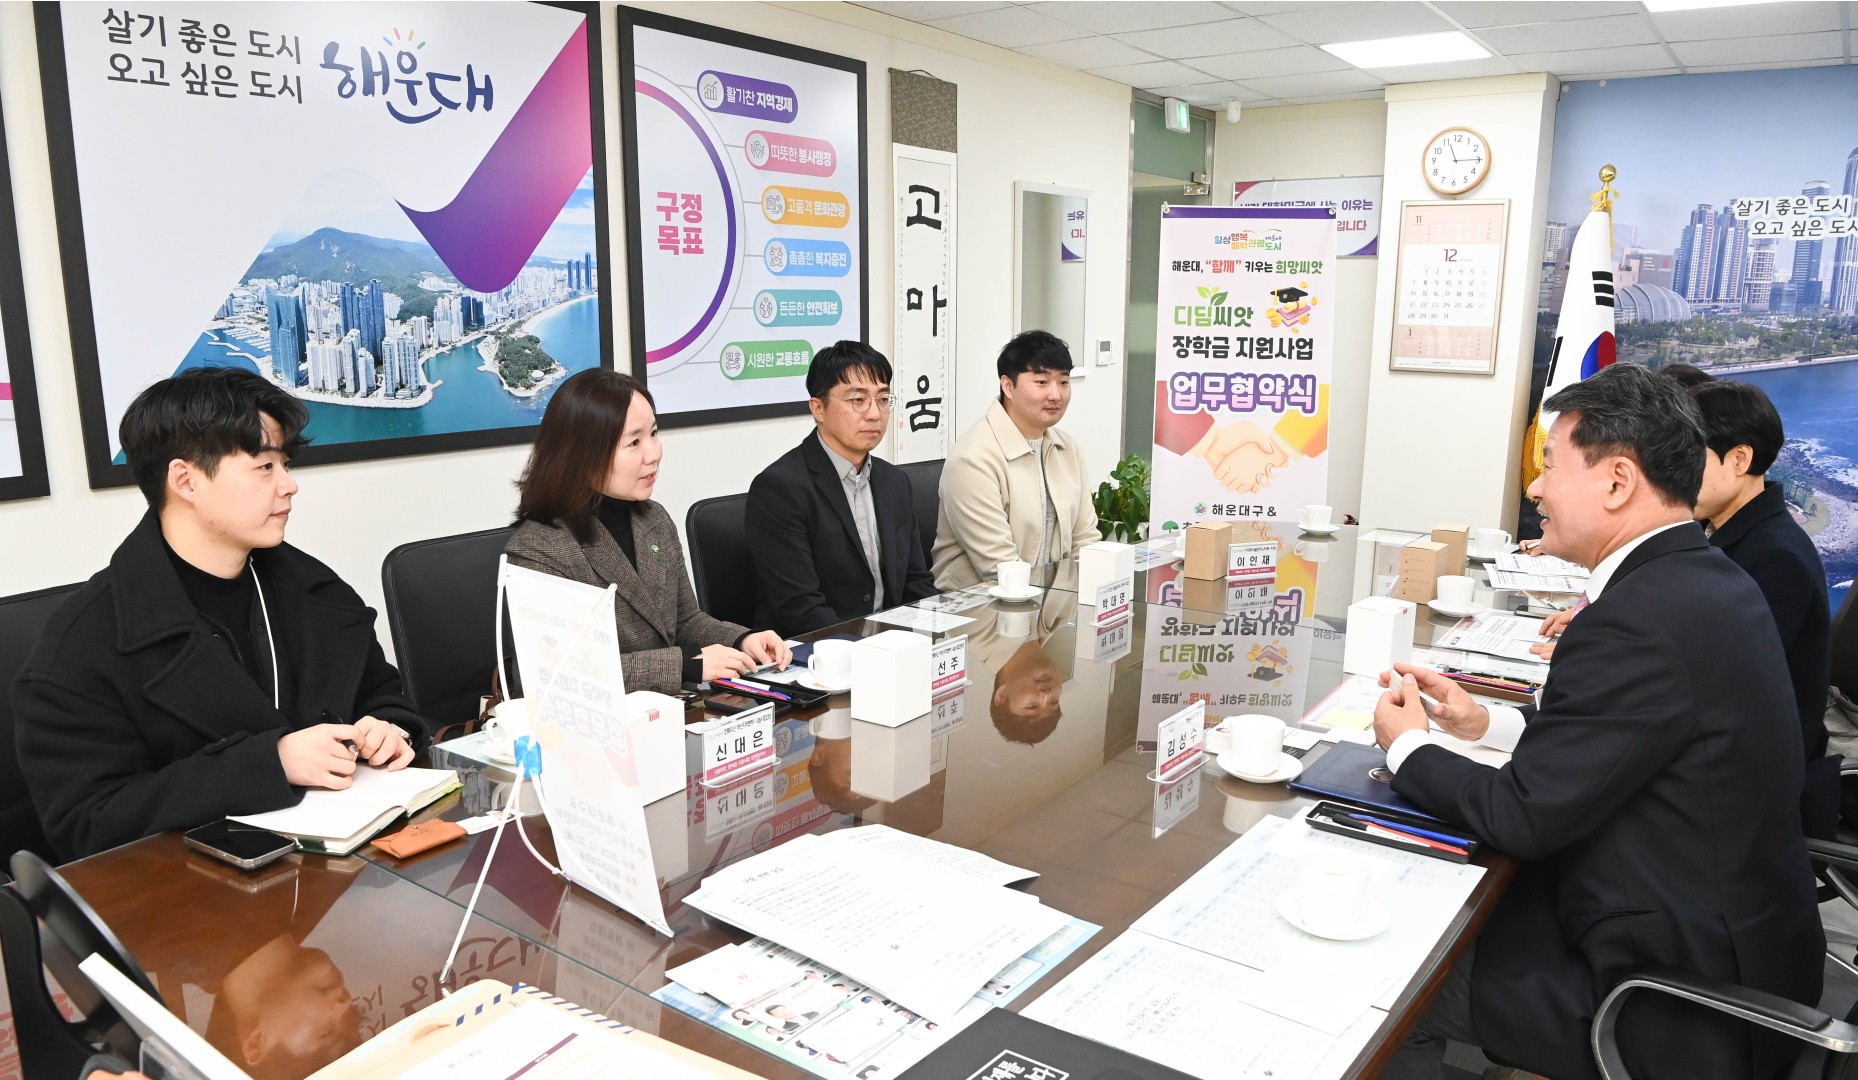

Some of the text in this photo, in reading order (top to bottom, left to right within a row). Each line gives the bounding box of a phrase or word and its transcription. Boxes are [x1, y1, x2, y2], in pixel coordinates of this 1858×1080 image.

[102, 8, 301, 64] 살기 좋은 도시
[107, 53, 303, 104] 오고 싶은 도시
[319, 40, 494, 124] 해운대
[726, 86, 793, 113] 활기찬 지역경제
[771, 143, 832, 167] 따뜻한 봉사행정
[1476, 156, 1480, 164] 3
[656, 191, 704, 224] 구정
[787, 198, 846, 218] 고품격 문화관광
[1341, 199, 1373, 211] 이유는
[1737, 198, 1849, 217] 살기 좋은 도시
[1751, 221, 1784, 235] 오고
[1791, 220, 1823, 237] 싶은
[657, 225, 705, 256] 목표
[789, 250, 847, 268] 촘촘한 복지증진
[1444, 249, 1457, 262] 12
[1171, 260, 1204, 273] 해운대,
[1245, 261, 1274, 273] 키우는
[1275, 260, 1323, 275] 희망씨앗
[779, 300, 839, 317] 든든한 안전확보
[1174, 305, 1254, 328] 디딤씨앗
[747, 349, 810, 369] 시원한 교통흐름
[1172, 335, 1314, 361] 장학금 지원사업
[1170, 372, 1317, 413] 업무협약식
[1212, 503, 1277, 517] 해운대구 &
[716, 730, 763, 762] 신대은
[1167, 727, 1198, 758] 김성수
